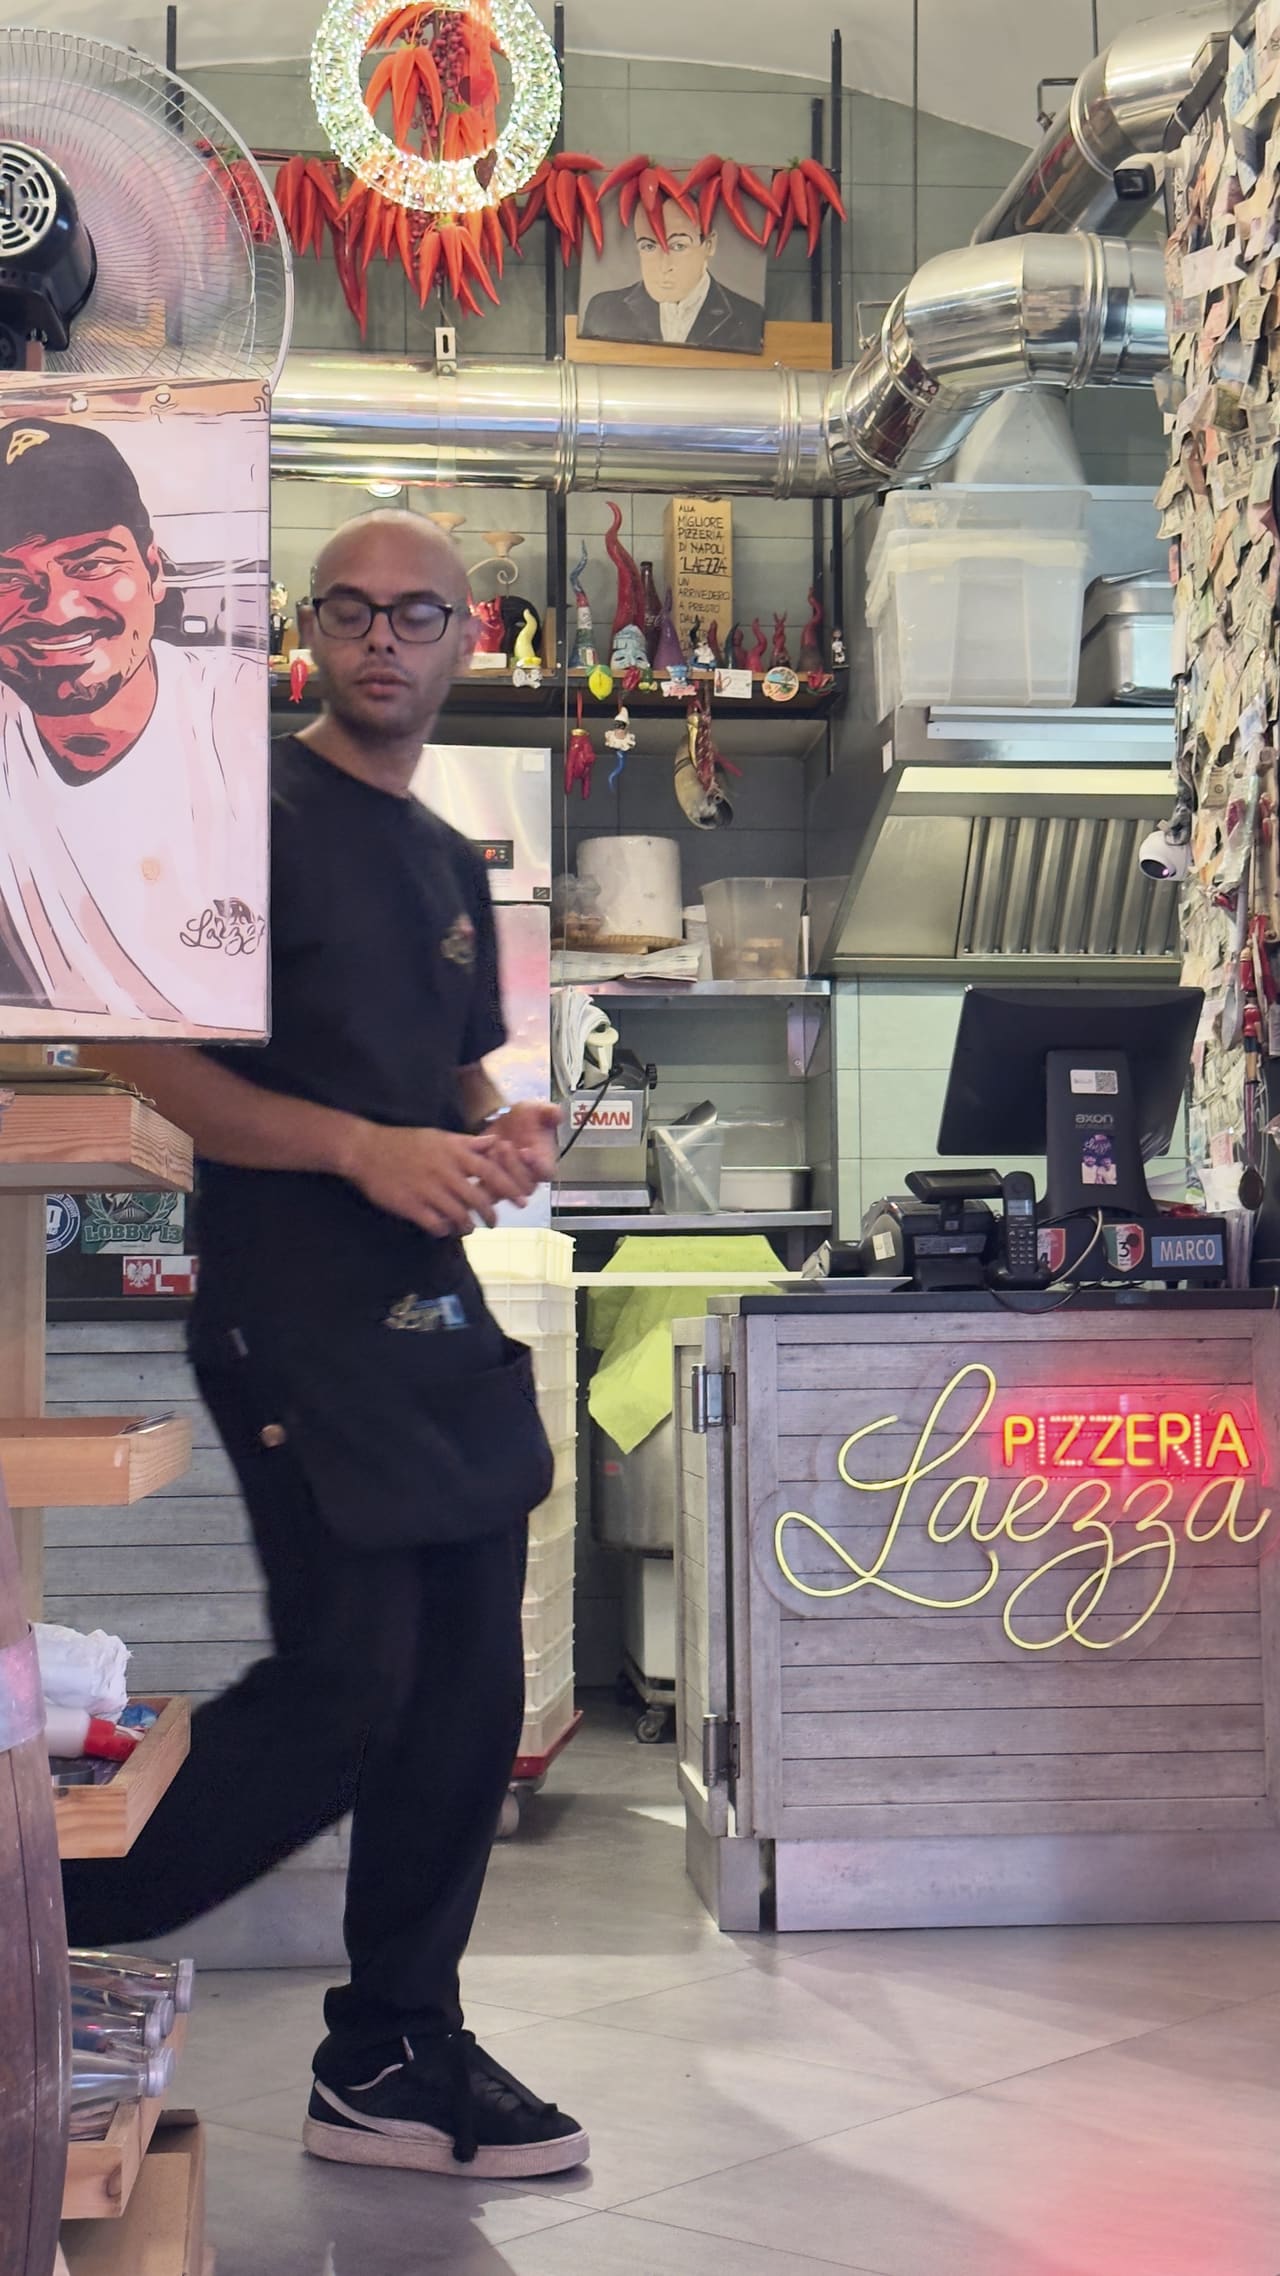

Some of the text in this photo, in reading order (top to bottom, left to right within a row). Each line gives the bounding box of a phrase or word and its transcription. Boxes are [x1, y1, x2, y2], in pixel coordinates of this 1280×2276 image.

[678, 504, 696, 513] ALLA
[678, 515, 724, 529] MIGLIORE
[678, 527, 724, 540] PIZZERIA
[690, 542, 725, 555] NAPOLI
[1075, 1113, 1114, 1123] axon
[84, 1224, 183, 1243] LOBBY'13
[1160, 1239, 1216, 1262] MARCO
[1003, 1413, 1251, 1468] PIZZERIA
[774, 1363, 1271, 1650] Laezza
